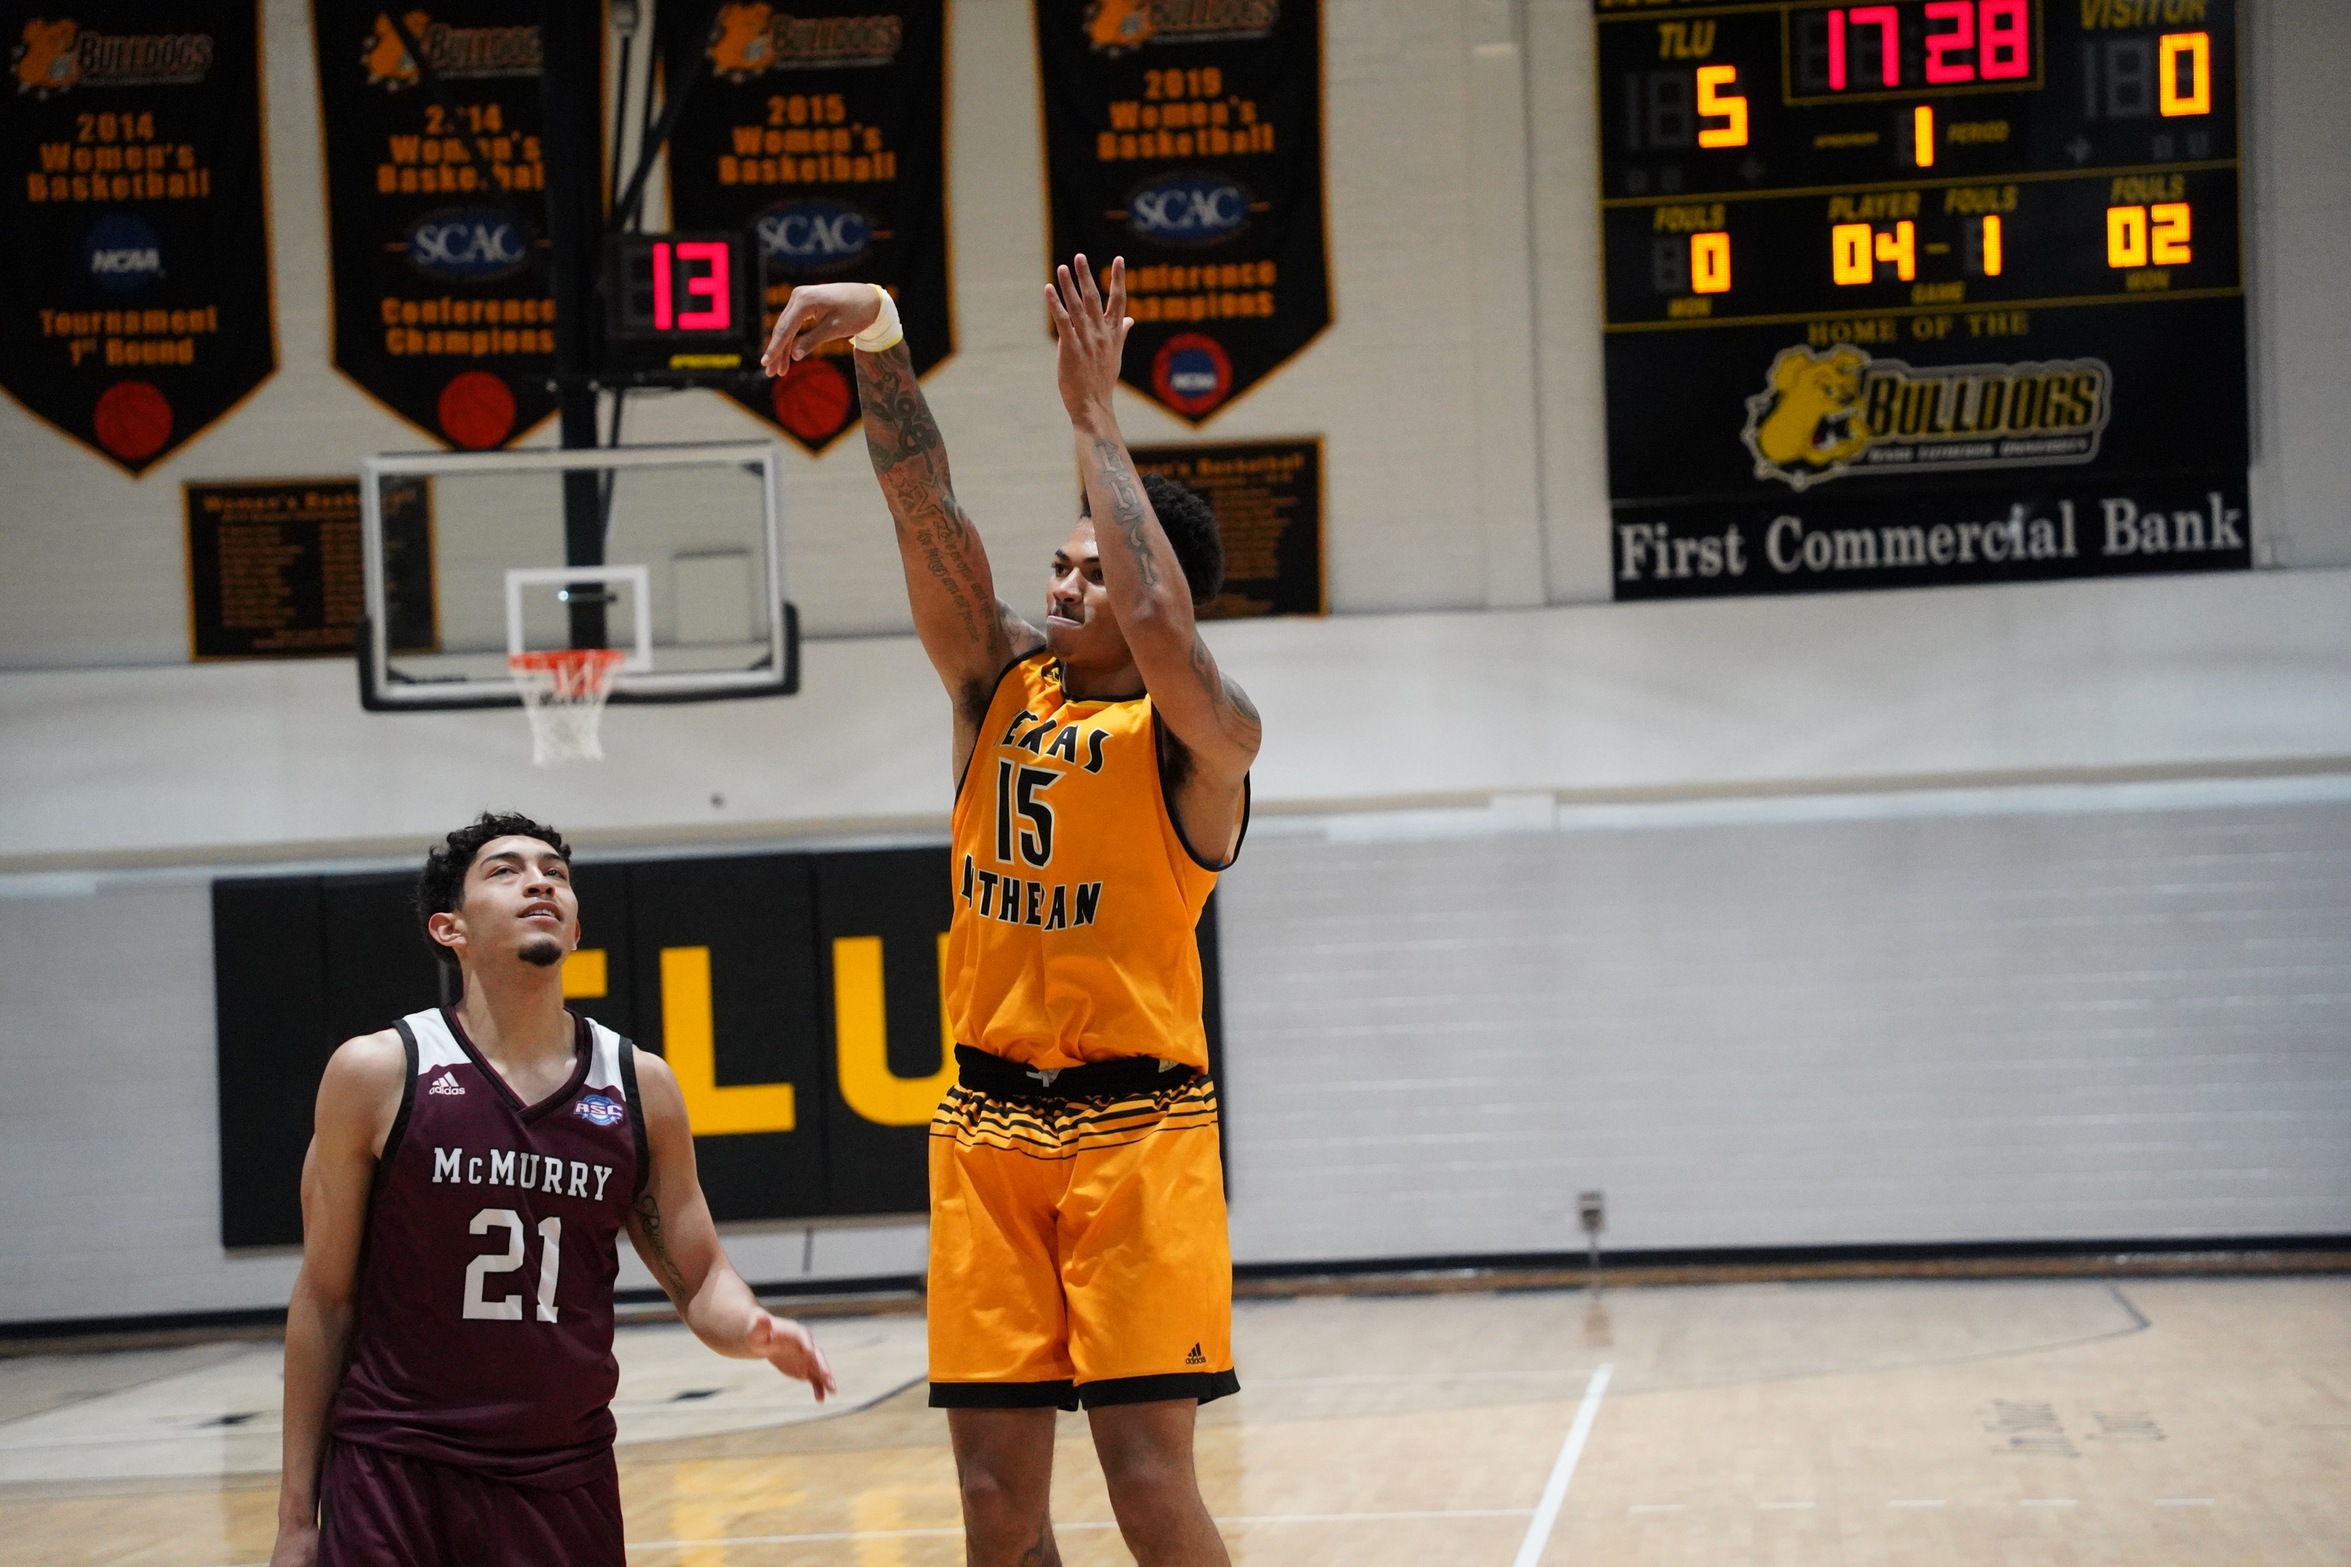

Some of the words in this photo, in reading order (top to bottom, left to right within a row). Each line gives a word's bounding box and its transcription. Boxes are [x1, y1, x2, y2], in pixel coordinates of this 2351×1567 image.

[1657, 20, 1717, 59] TLU
[2159, 31, 2211, 117] 0
[425, 103, 503, 136] 214
[768, 94, 847, 127] 2015
[1109, 94, 1257, 131] Women's
[1696, 64, 1749, 149] 5
[77, 112, 155, 142] 2014
[732, 122, 882, 156] Women's
[1097, 122, 1276, 161] Basketball
[1914, 105, 1935, 168] 1
[41, 143, 196, 173] Women's
[719, 151, 897, 186] Basketball
[28, 167, 212, 202] Basketball
[1827, 191, 1922, 222] PLAYER
[1943, 184, 2018, 215] FOULS
[2110, 175, 2188, 204] FOULS
[1134, 187, 1242, 232] SCAC
[1653, 203, 1727, 234] FOULS
[414, 223, 526, 264] SCAC
[758, 211, 867, 258] SCAC
[1832, 219, 1917, 286] 04
[1982, 213, 2002, 277] 1
[2106, 201, 2192, 269] 02
[91, 248, 161, 274] NCAA
[1690, 231, 1732, 295] 0
[652, 241, 731, 331] 13
[41, 305, 219, 337] Tournament
[1806, 320, 1897, 347] HOME
[1912, 315, 1954, 340] OF
[1966, 311, 2031, 338] THE
[105, 338, 196, 366] Round
[1866, 368, 2100, 438] BULLDOGS
[1617, 521, 1748, 580] First
[1765, 499, 2078, 575] Commercial
[2102, 490, 2245, 557] Bank
[996, 757, 1067, 870] 15
[562, 935, 962, 1138] LU
[429, 1082, 466, 1096] adidas
[574, 1101, 624, 1119] ASC
[432, 1147, 613, 1201] McMURRY
[462, 1208, 562, 1324] 21
